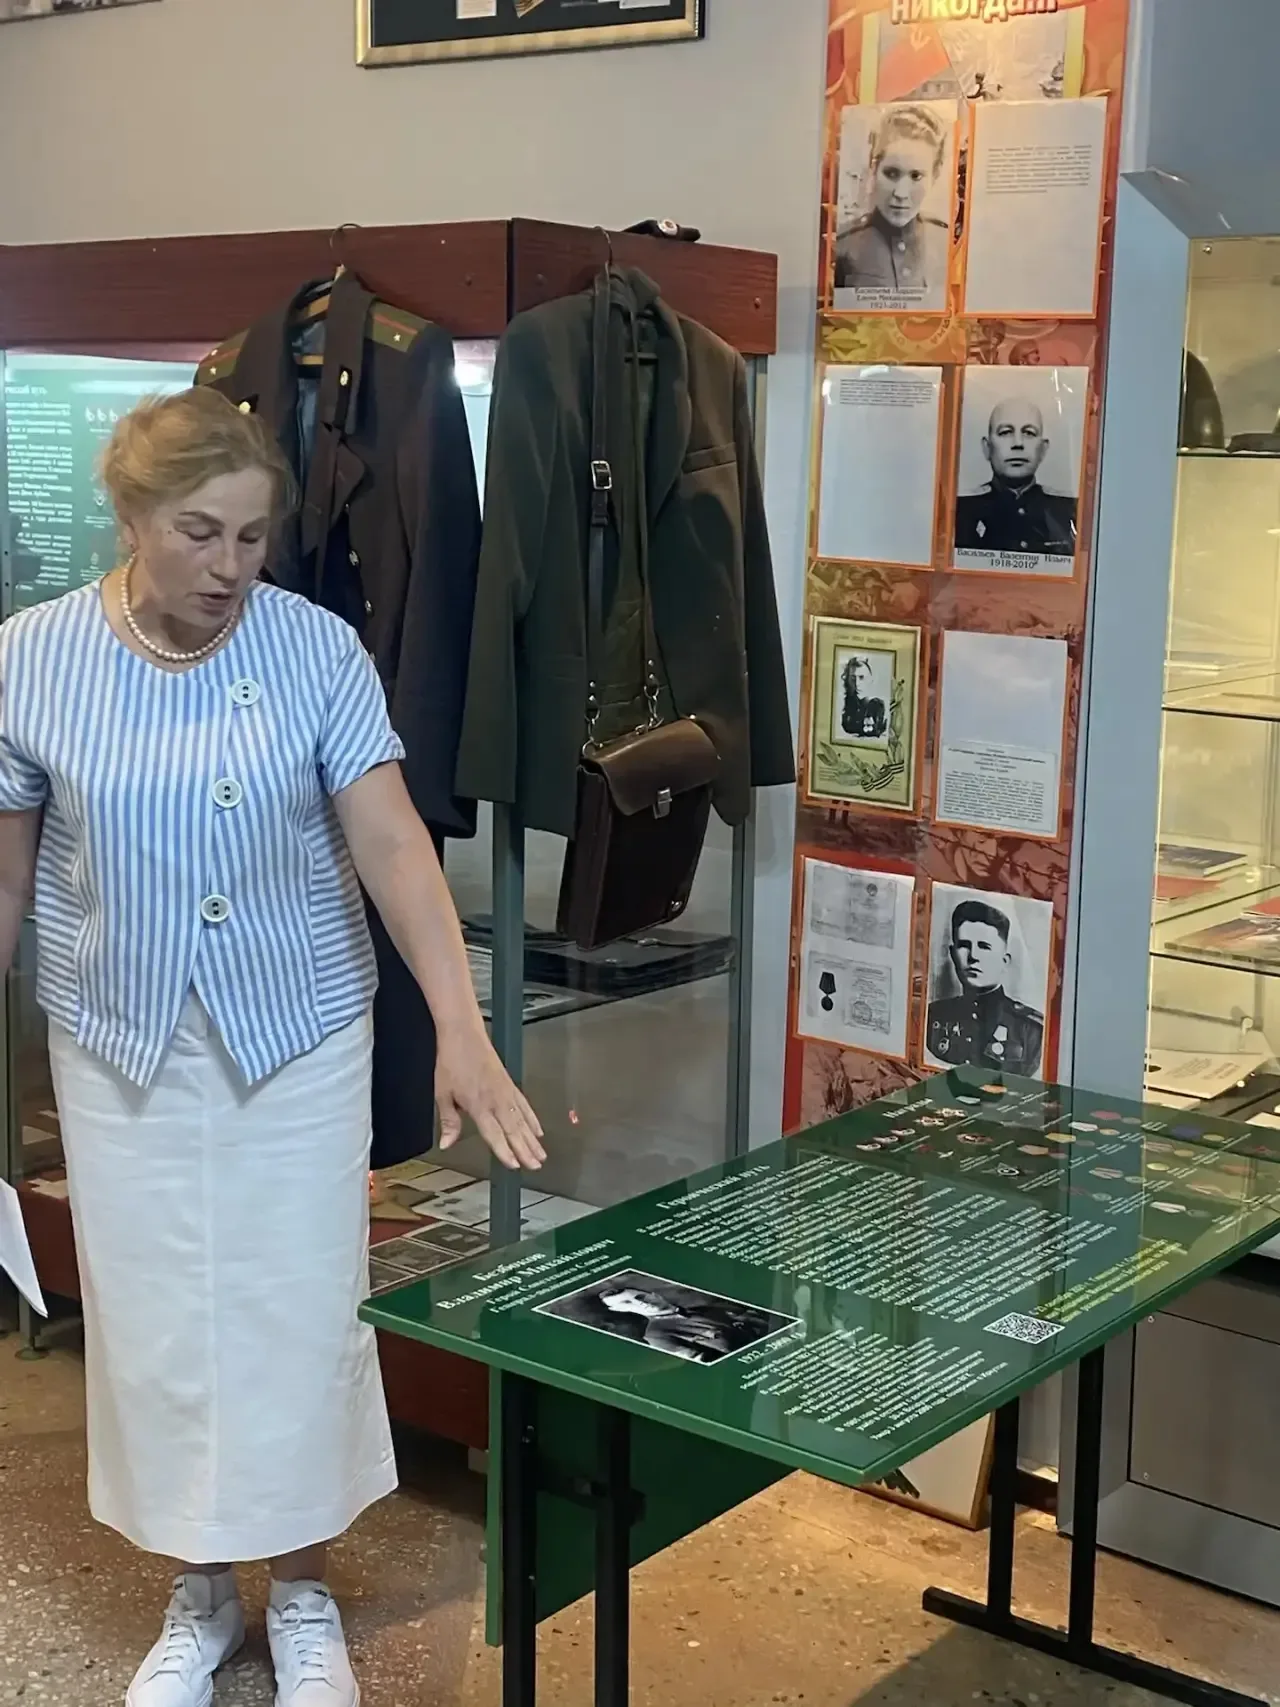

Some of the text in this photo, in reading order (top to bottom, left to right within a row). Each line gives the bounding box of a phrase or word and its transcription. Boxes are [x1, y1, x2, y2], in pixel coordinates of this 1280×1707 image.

[957, 548, 996, 558] Васильев
[1000, 551, 1040, 562] Валентин
[653, 1175, 743, 1209] Героический
[433, 1237, 617, 1309] Владимир Михайлович
[468, 1252, 549, 1281] Безбоков
